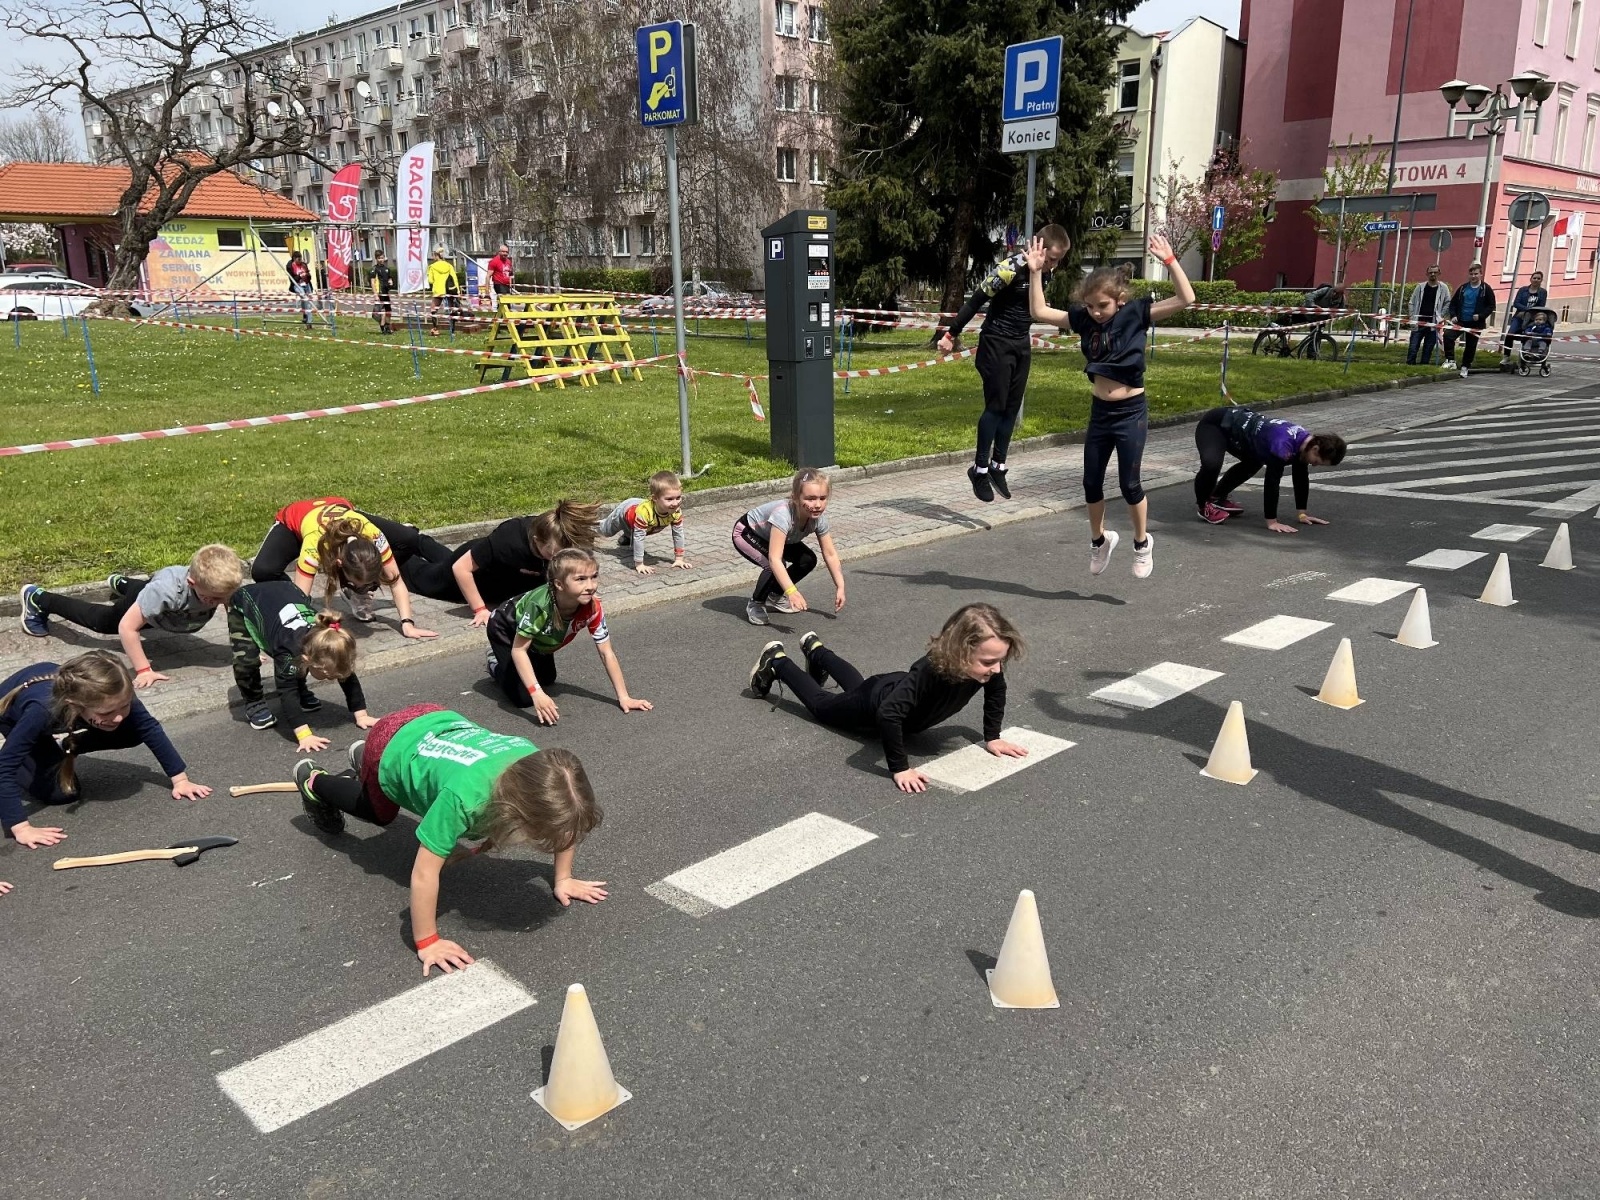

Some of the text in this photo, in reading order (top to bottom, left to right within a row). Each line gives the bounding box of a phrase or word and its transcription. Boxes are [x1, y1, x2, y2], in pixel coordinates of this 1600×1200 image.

[649, 30, 672, 73] P
[1014, 49, 1049, 111] P
[1026, 100, 1056, 112] Płatny
[644, 108, 681, 122] PARKOMAT
[1008, 128, 1051, 144] Koniec
[1456, 163, 1467, 178] 4
[160, 223, 187, 232] KUP
[160, 249, 211, 258] ZAMIANA
[771, 240, 782, 258] P
[162, 263, 202, 272] SERWIS
[171, 275, 191, 284] SIM
